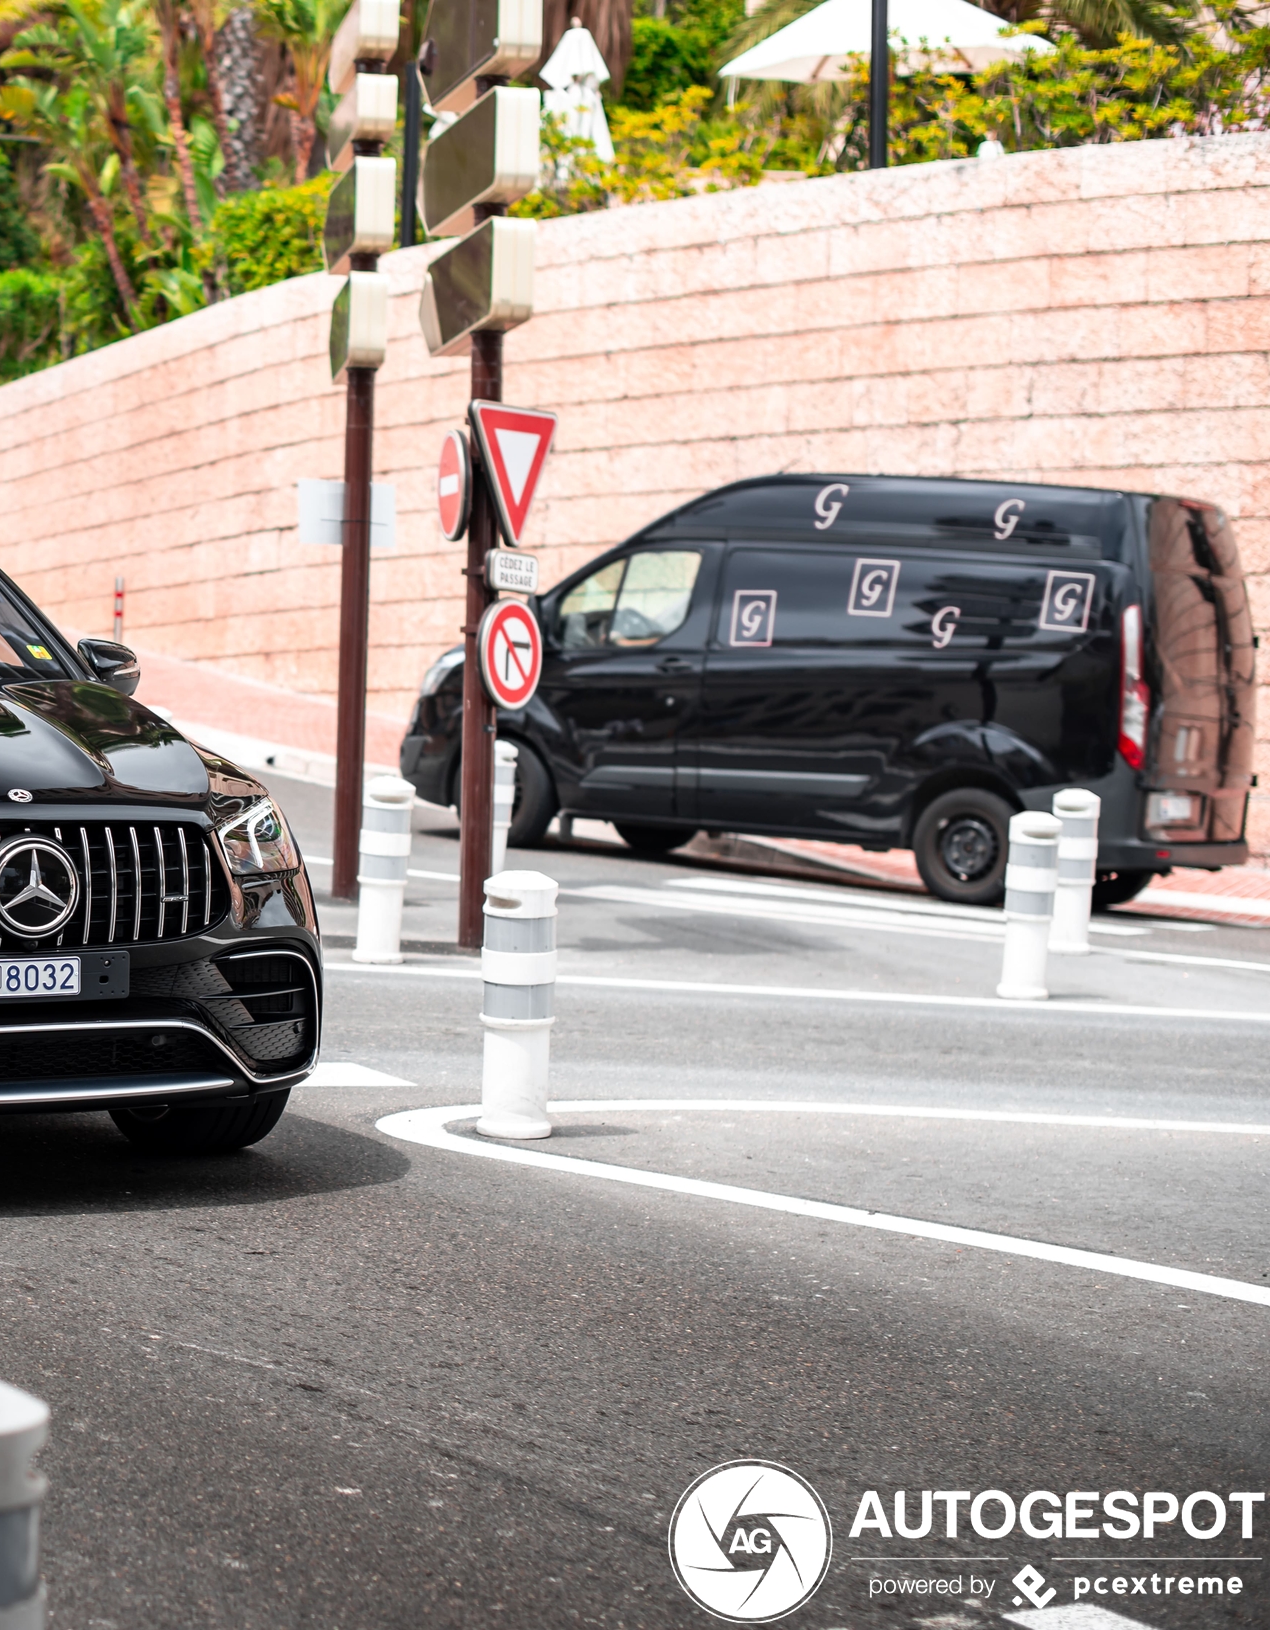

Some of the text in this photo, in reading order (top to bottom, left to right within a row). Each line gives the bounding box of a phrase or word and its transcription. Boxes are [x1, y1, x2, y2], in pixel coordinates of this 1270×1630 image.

[500, 556, 534, 573] CÉDEZ LE
[501, 572, 532, 587] PASSAGE
[6, 964, 74, 991] 8032
